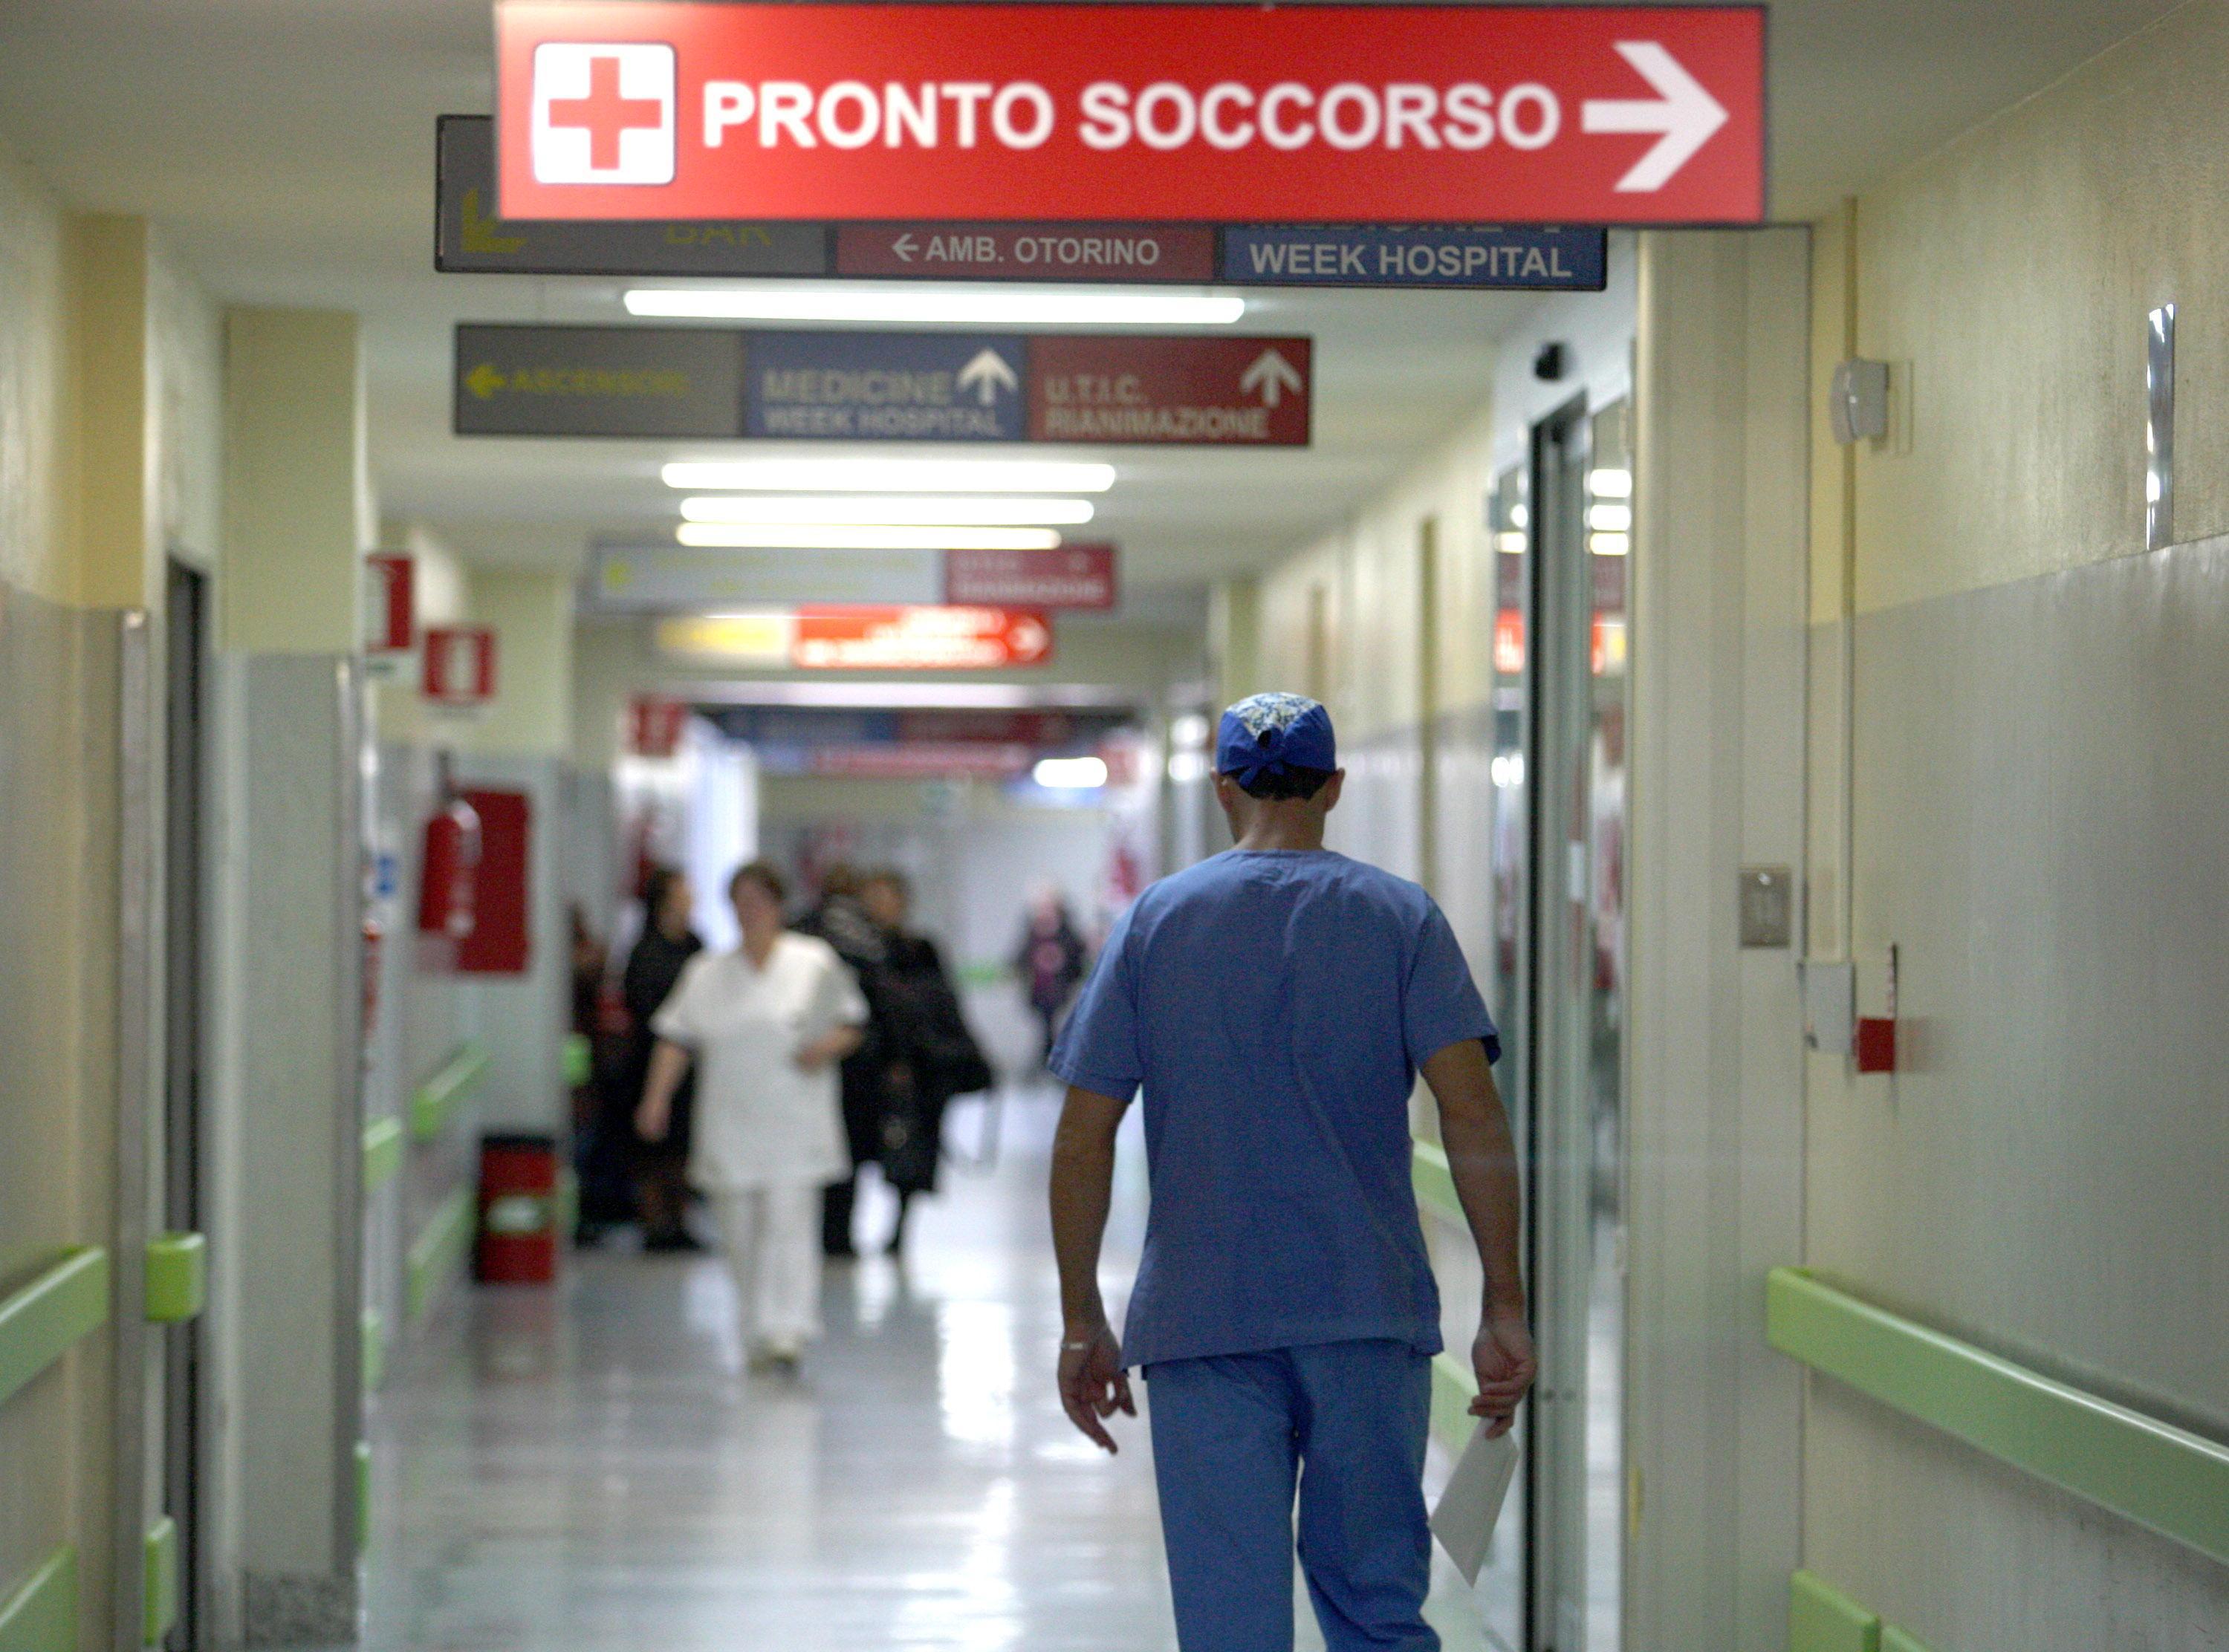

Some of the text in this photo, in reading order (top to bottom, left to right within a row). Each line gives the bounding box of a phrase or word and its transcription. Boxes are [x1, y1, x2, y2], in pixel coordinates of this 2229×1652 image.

[702, 81, 1562, 150] PRONTO SOCCORSO
[925, 236, 1161, 265] AMB. OTORINO
[1249, 243, 1573, 278] WEEK HOSPITAL
[762, 368, 953, 403] MEDICINE
[762, 406, 1004, 438] WEEK HOSPITAL
